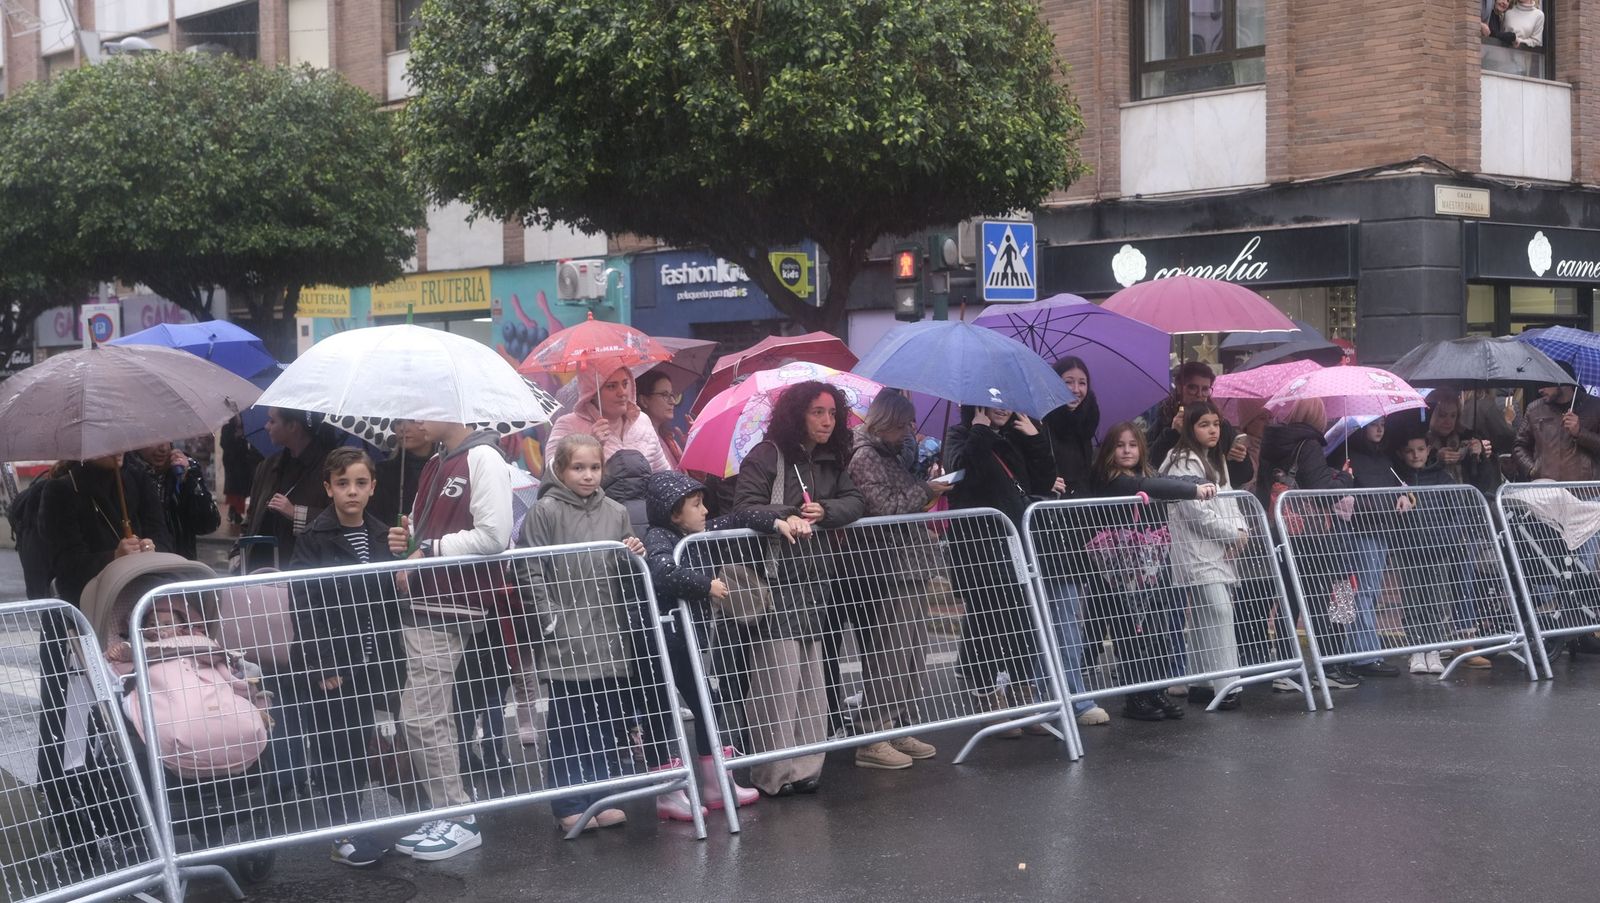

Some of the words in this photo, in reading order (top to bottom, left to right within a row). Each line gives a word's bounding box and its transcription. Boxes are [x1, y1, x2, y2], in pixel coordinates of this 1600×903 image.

[1153, 235, 1268, 281] camelia
[782, 269, 799, 279] kids
[421, 275, 486, 306] FRUTERIA
[709, 289, 723, 299] para
[723, 286, 748, 298] niños
